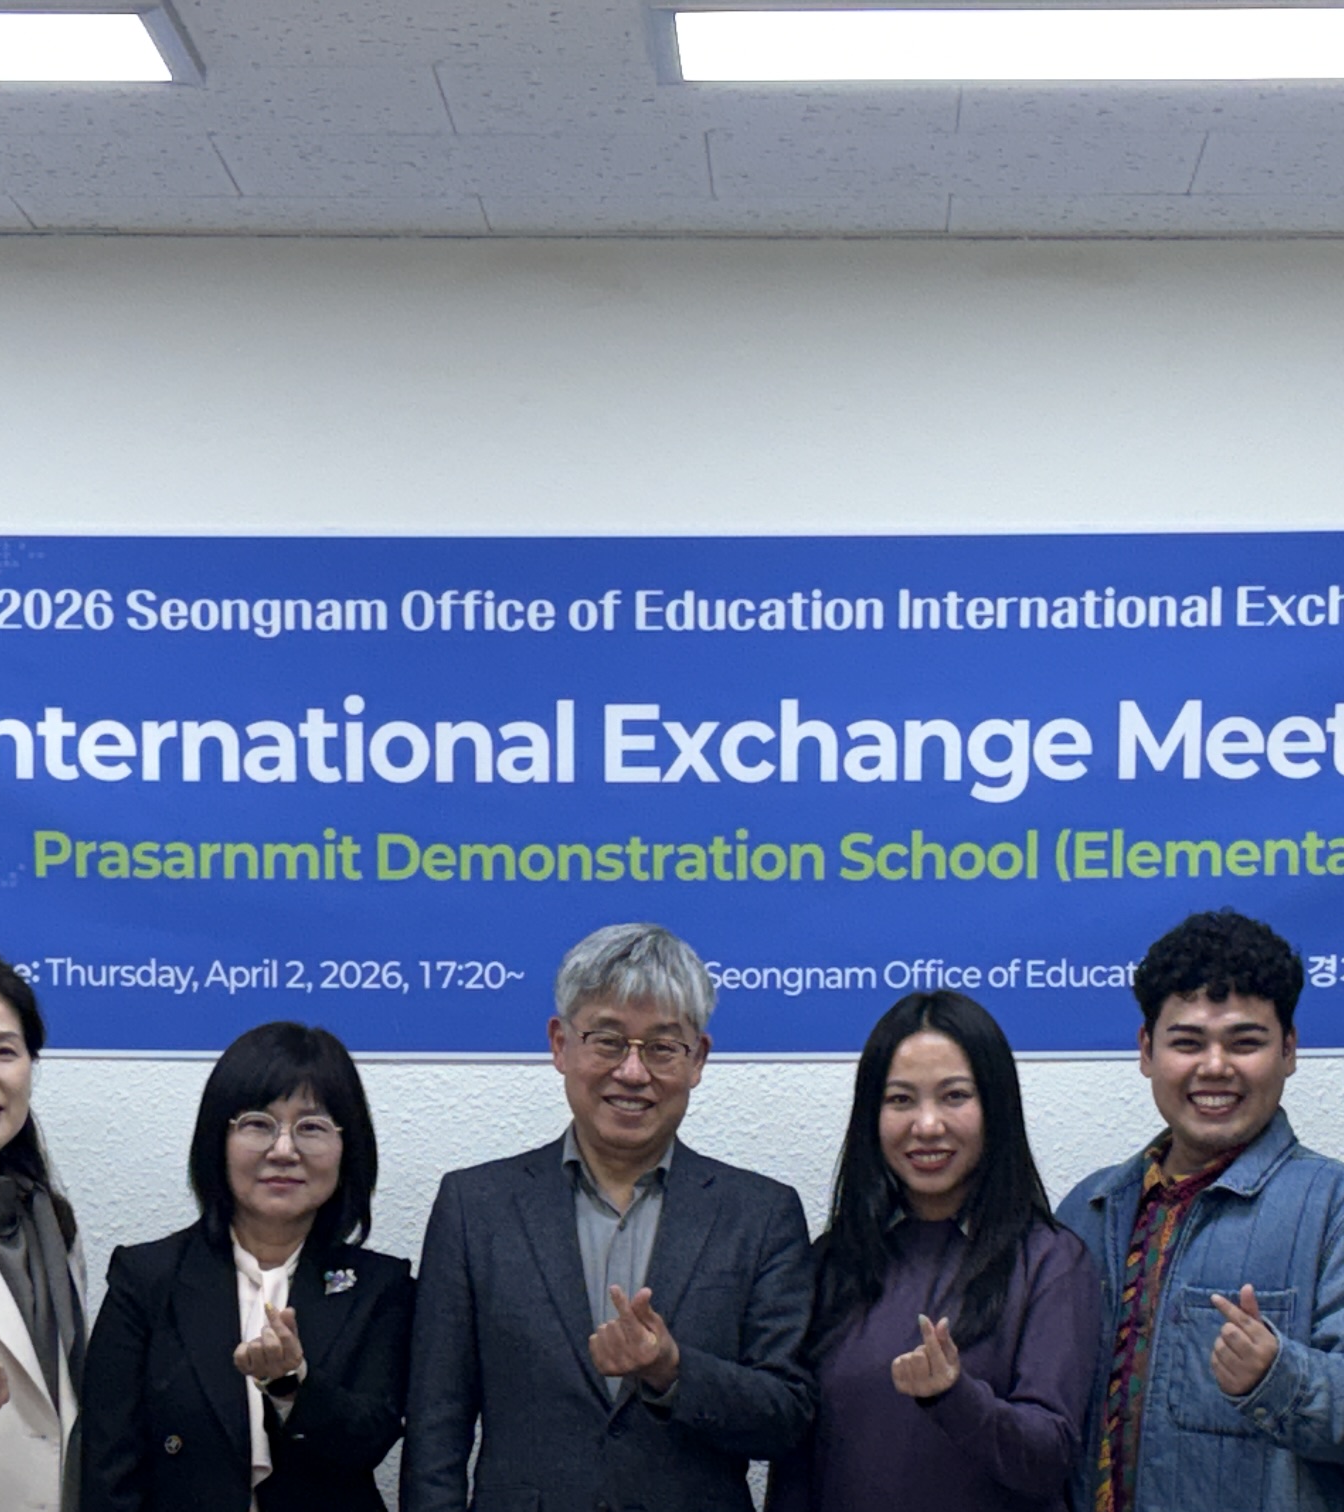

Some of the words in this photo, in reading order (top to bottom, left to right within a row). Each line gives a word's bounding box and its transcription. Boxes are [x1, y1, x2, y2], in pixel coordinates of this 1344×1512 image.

[126, 589, 387, 638] Seongnam
[401, 590, 555, 631] Office
[568, 590, 621, 631] of
[636, 589, 884, 631] Education
[899, 586, 1222, 631] International
[604, 699, 1093, 803] Exchange
[34, 827, 361, 881] Prasarnmit
[377, 828, 825, 881] Demonstration
[839, 829, 1038, 881] School
[45, 957, 198, 994] Thursday,
[205, 958, 279, 994] April
[286, 960, 312, 991] 2,
[321, 960, 409, 991] 2026,
[420, 960, 524, 989] 17:20~
[704, 960, 876, 996] Seongnam
[884, 959, 982, 989] Office
[988, 958, 1021, 988] of
[1027, 958, 1140, 988] Educat
